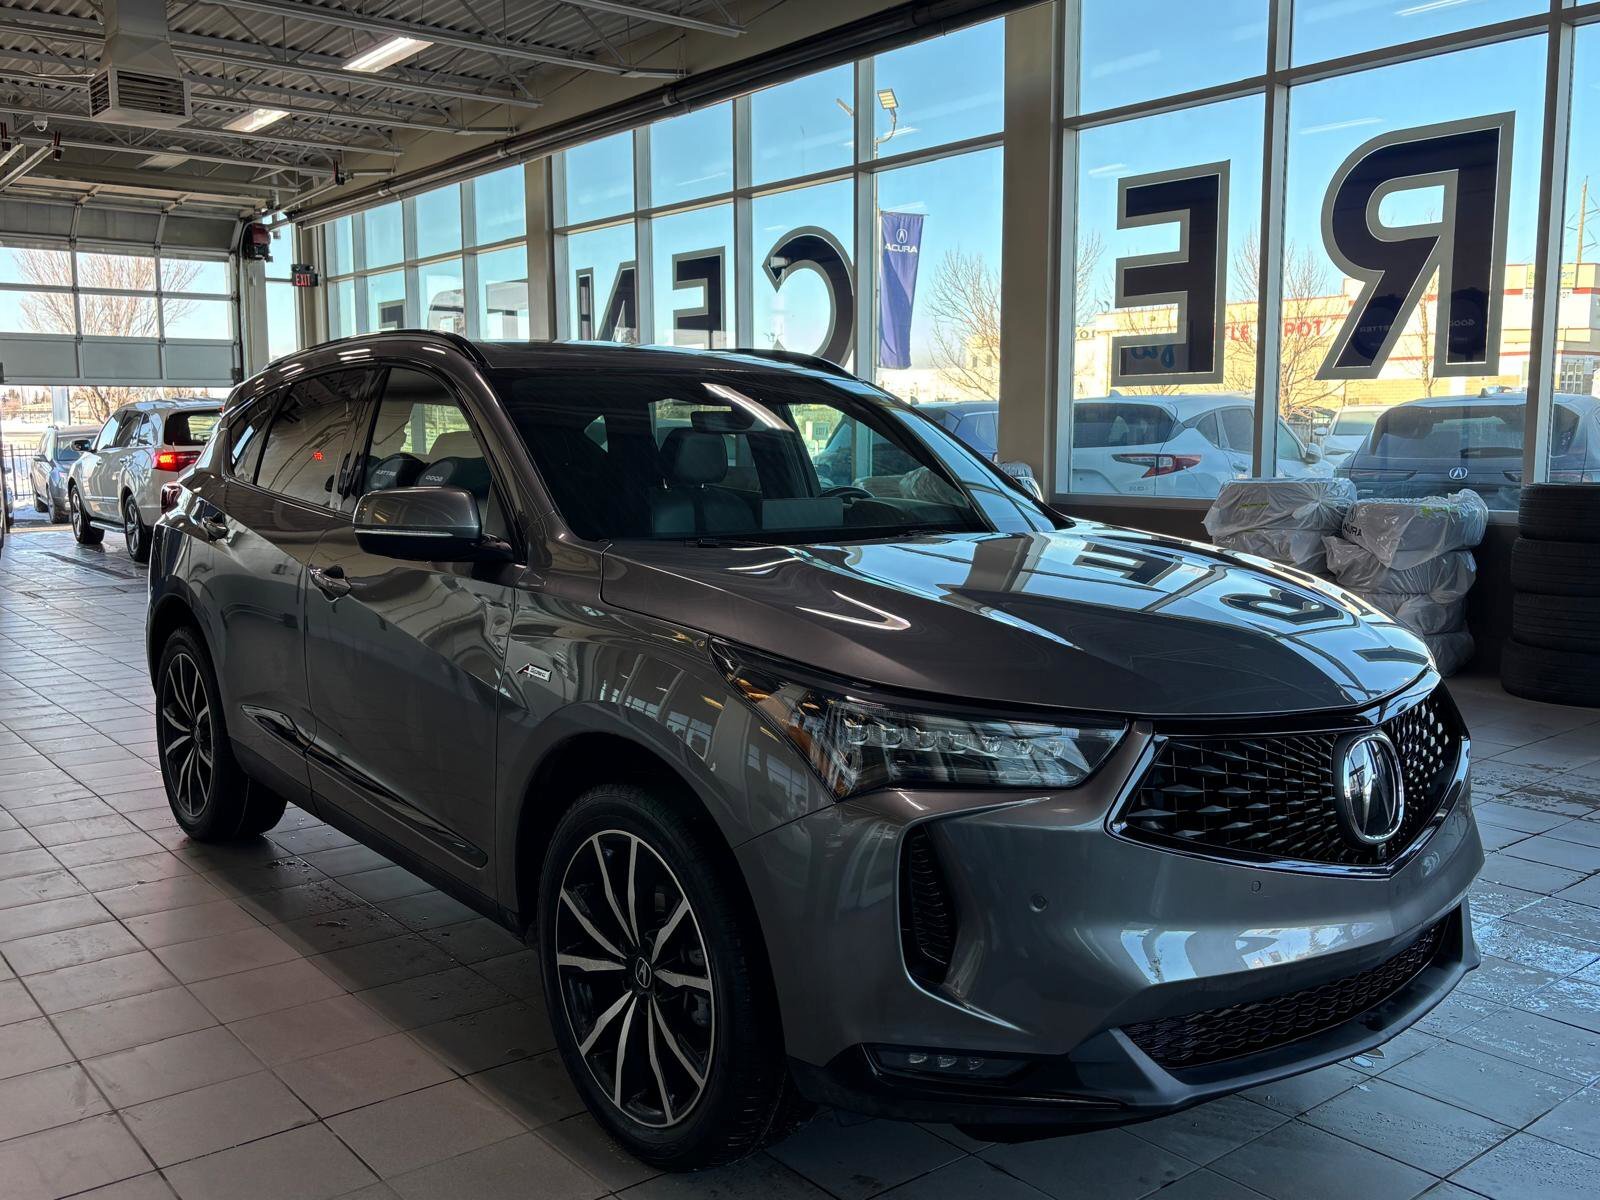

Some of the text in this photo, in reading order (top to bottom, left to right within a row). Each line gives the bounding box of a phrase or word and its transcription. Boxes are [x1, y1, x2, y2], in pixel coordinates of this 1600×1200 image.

[885, 243, 918, 253] ACURA
[295, 273, 311, 286] EXIT
[1284, 319, 1323, 337] POT
